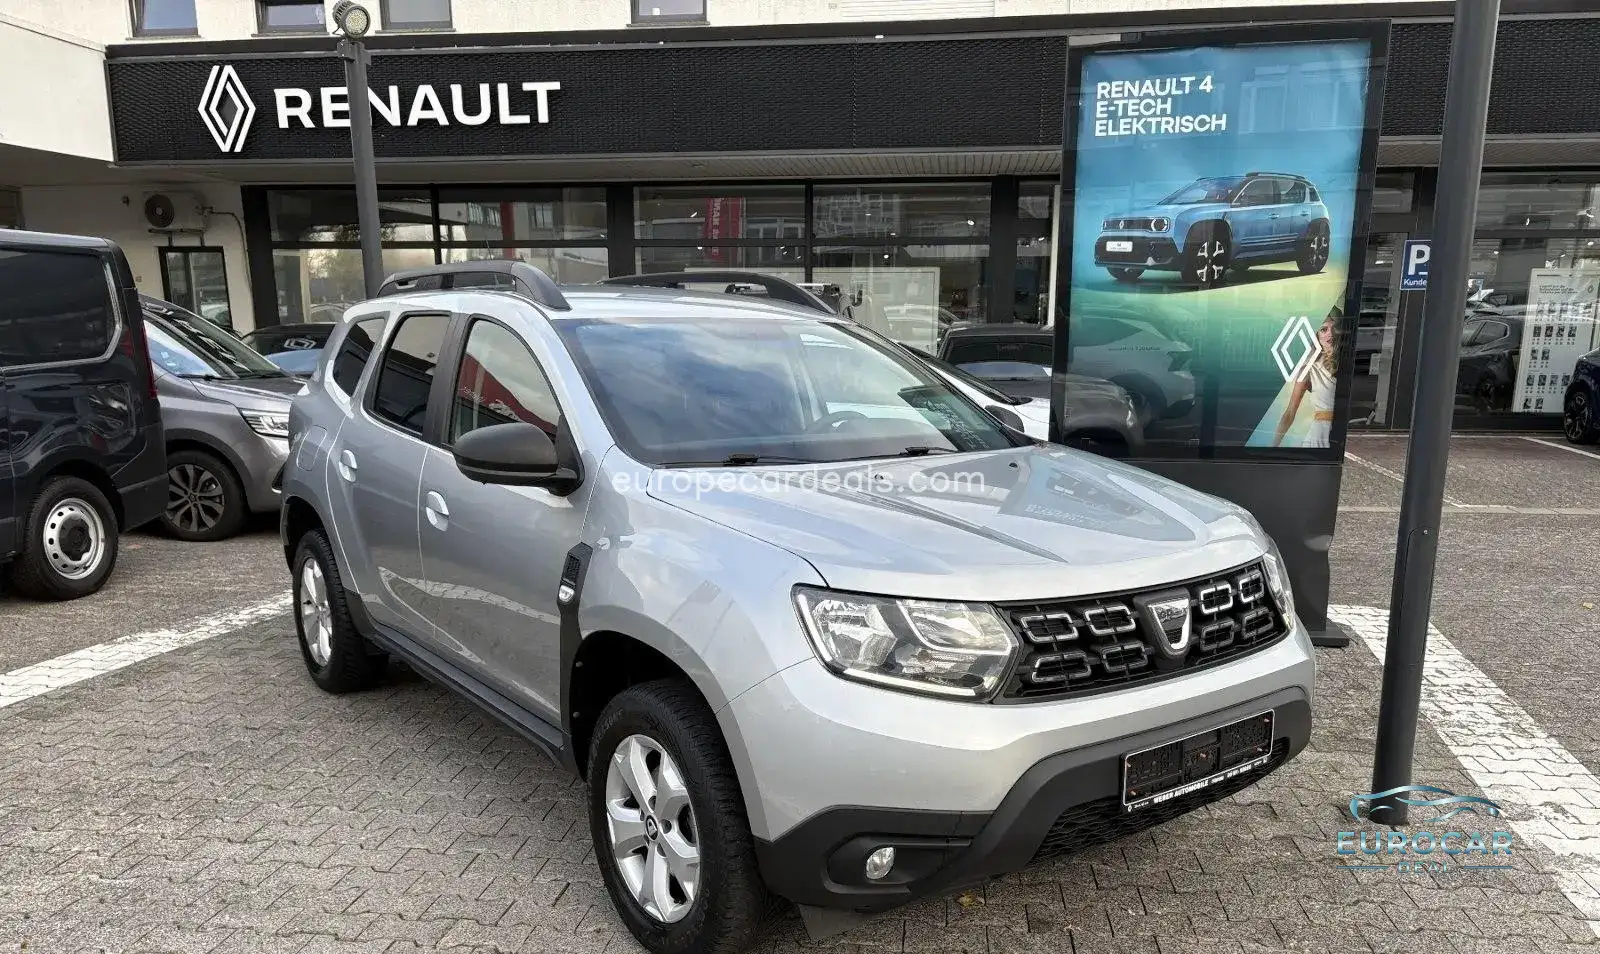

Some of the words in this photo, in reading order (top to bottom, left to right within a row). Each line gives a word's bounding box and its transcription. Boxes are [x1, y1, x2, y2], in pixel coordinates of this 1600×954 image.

[1096, 76, 1196, 99] RENAULT
[1198, 75, 1213, 93] 4
[273, 81, 561, 129] RENAULT
[1096, 98, 1172, 118] E-TECH
[1095, 113, 1227, 137] ELEKTRISCH
[1408, 244, 1431, 275] P
[1153, 792, 1174, 803] WEBER
[1174, 779, 1209, 797] AUTOMOBILE
